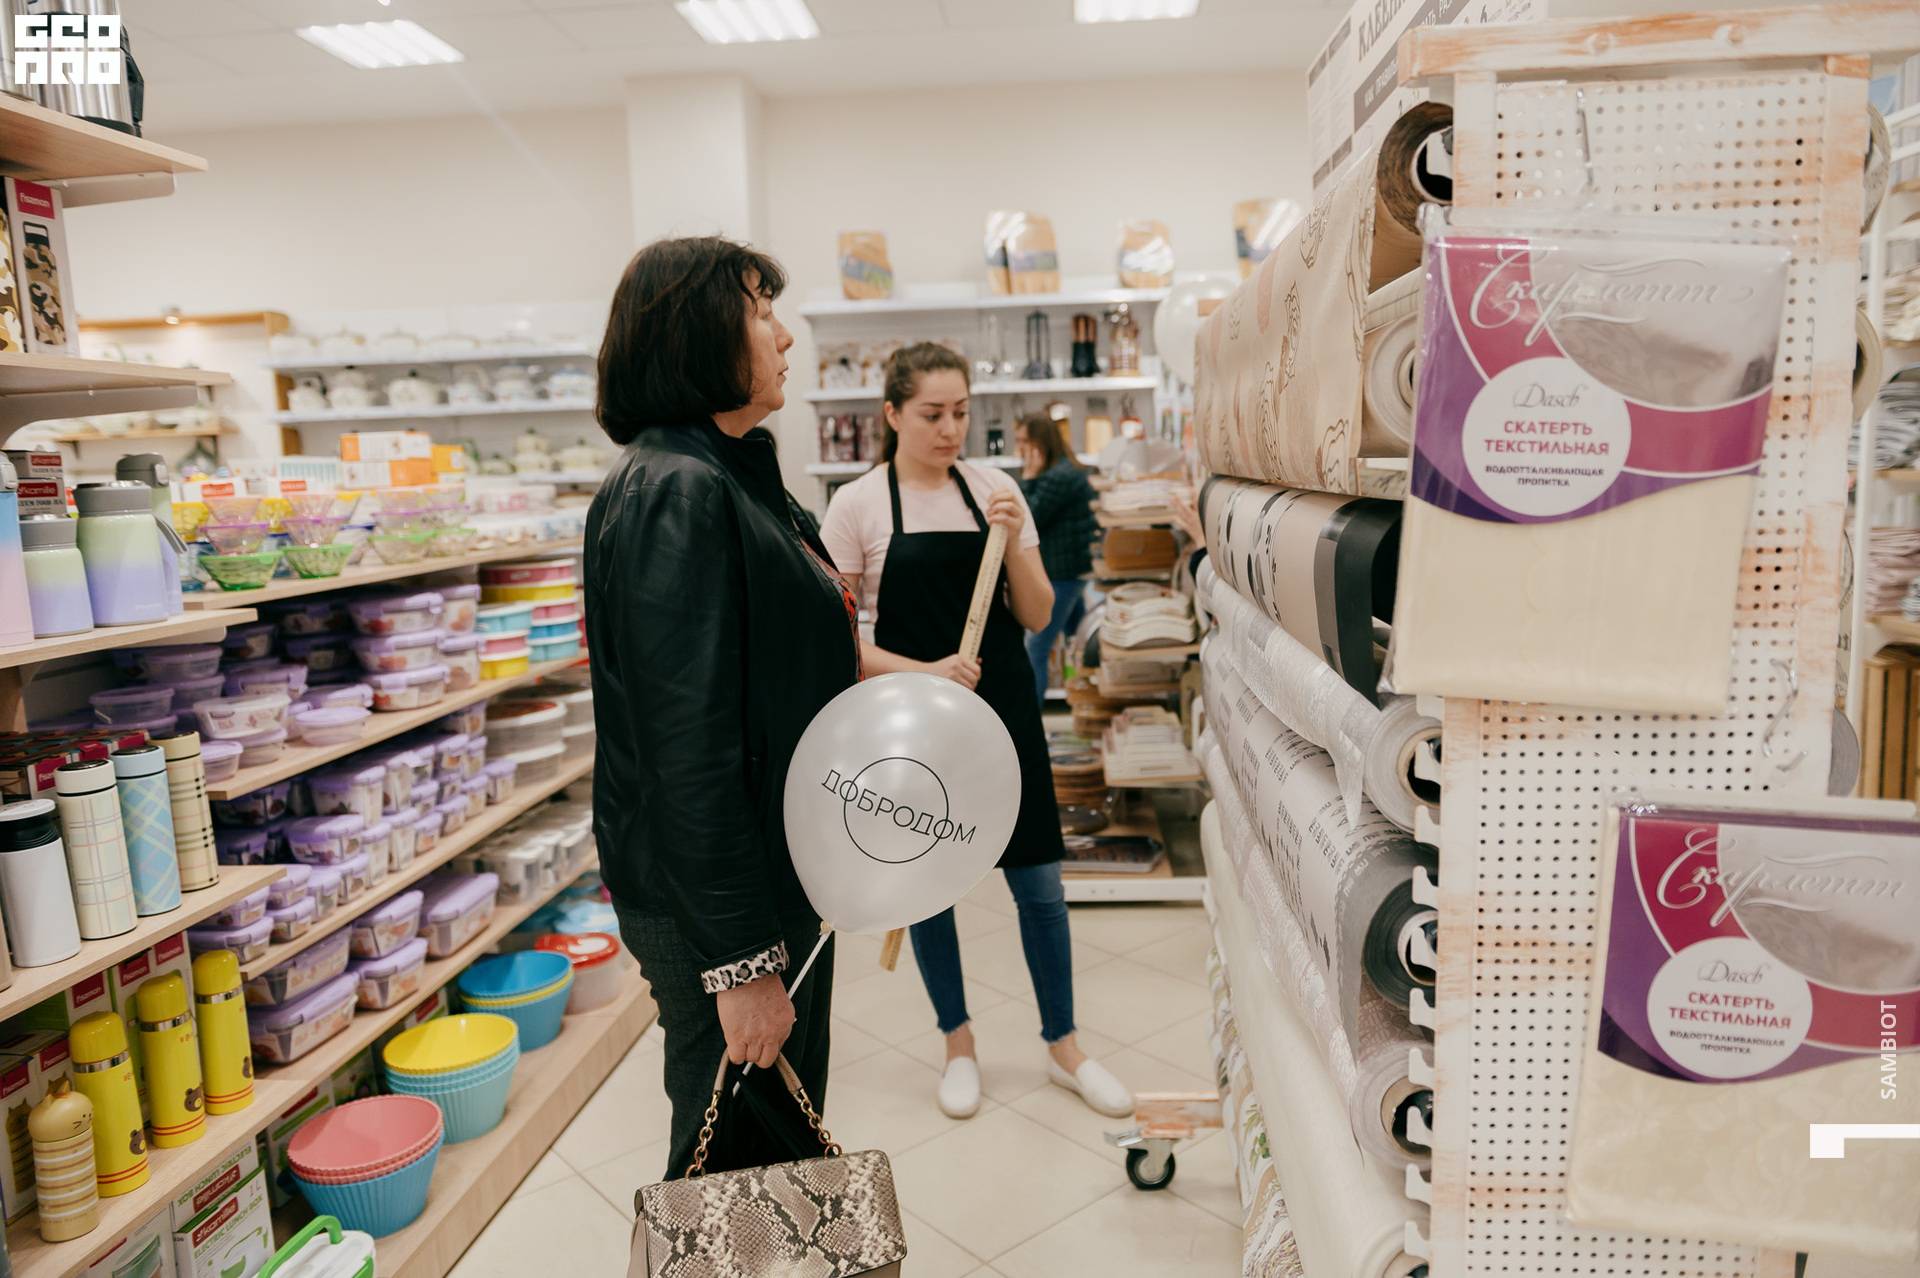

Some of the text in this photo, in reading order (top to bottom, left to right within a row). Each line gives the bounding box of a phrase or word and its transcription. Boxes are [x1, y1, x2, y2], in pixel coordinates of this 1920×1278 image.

[1469, 245, 1740, 347] Скарлетт
[1513, 382, 1585, 408] Dasch
[1503, 420, 1593, 436] СКАТЕРТЬ
[1484, 439, 1610, 455] ТЕКСТИЛЬНАЯ
[1485, 465, 1604, 476] ВОДООТТАЛКИВАЮЩАЯ
[1517, 477, 1570, 486] ПРОПИТКА
[821, 769, 977, 845] ДОБРОДОМ
[1656, 828, 1906, 928] Скарлетт
[1698, 960, 1768, 984] Dasch
[1687, 991, 1776, 1011] СКАТЕРТЬ
[1668, 1006, 1792, 1030] ТЕКСТИЛЬНАЯ
[1669, 1029, 1786, 1047] ВОДООТТАЛКИВАЮЩАЯ
[1700, 1043, 1752, 1055] ПРОПИТКА
[194, 1168, 220, 1193] LUNCH
[177, 1189, 194, 1208] BOX
[226, 1209, 249, 1232] LUNCH
[249, 1194, 263, 1211] BOX
